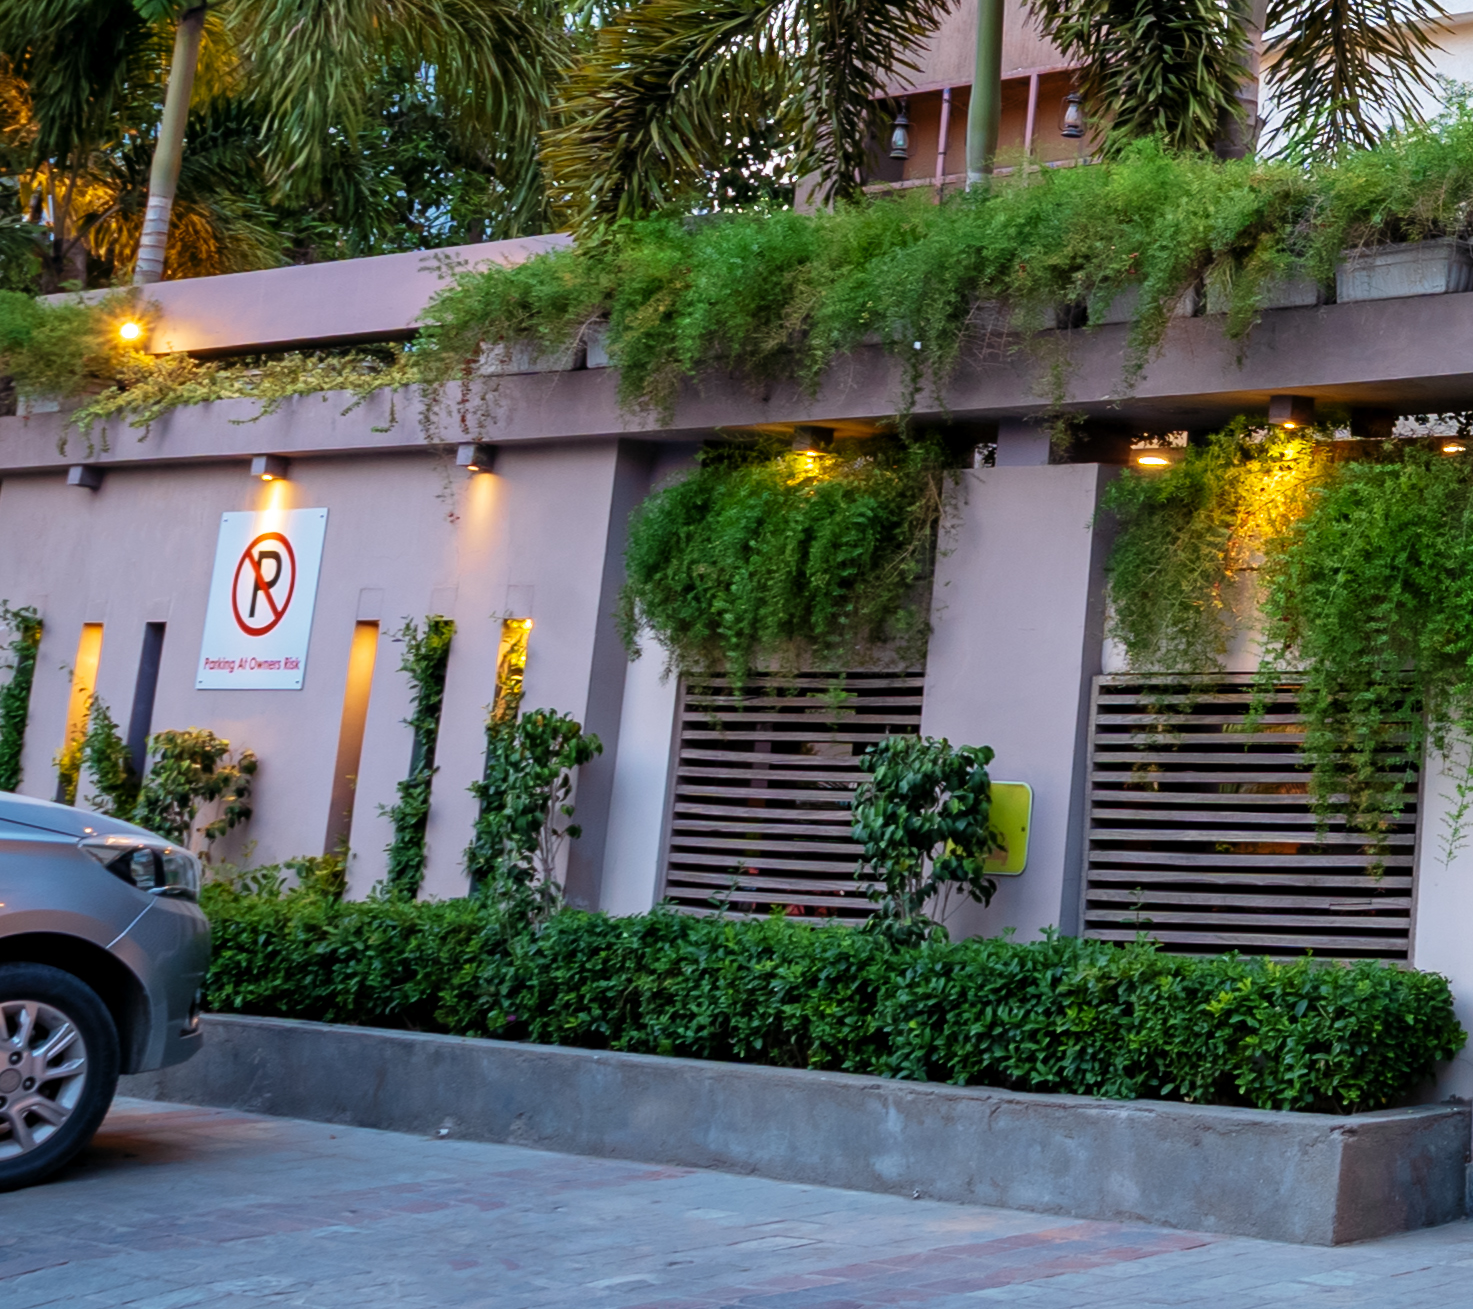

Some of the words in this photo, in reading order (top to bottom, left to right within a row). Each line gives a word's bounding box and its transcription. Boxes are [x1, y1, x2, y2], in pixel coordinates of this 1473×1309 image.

[204, 656, 236, 673] Parking
[237, 656, 248, 670] At
[249, 656, 281, 671] Owners
[283, 656, 301, 670] Risk
